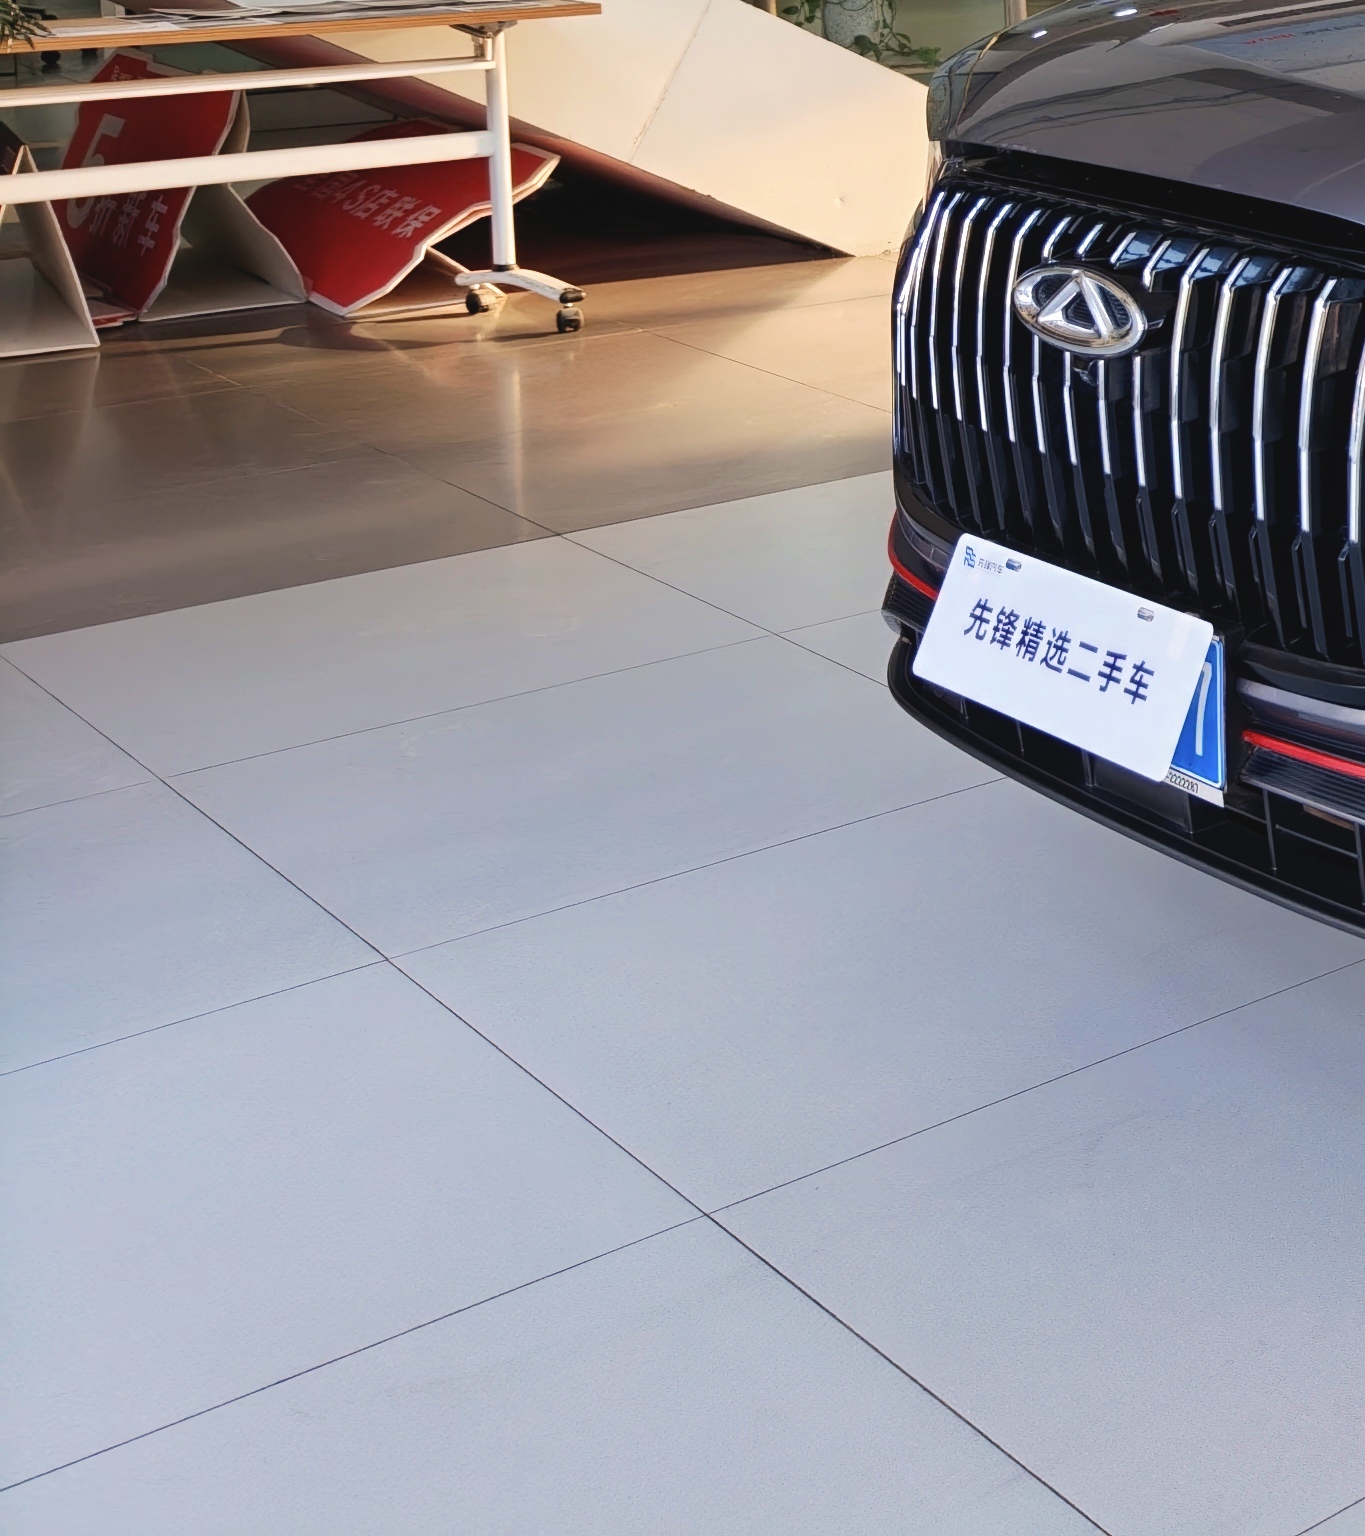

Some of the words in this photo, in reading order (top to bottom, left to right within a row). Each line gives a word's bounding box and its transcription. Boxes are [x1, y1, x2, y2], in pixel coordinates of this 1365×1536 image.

[963, 598, 1155, 706] 先锋精选二手车
